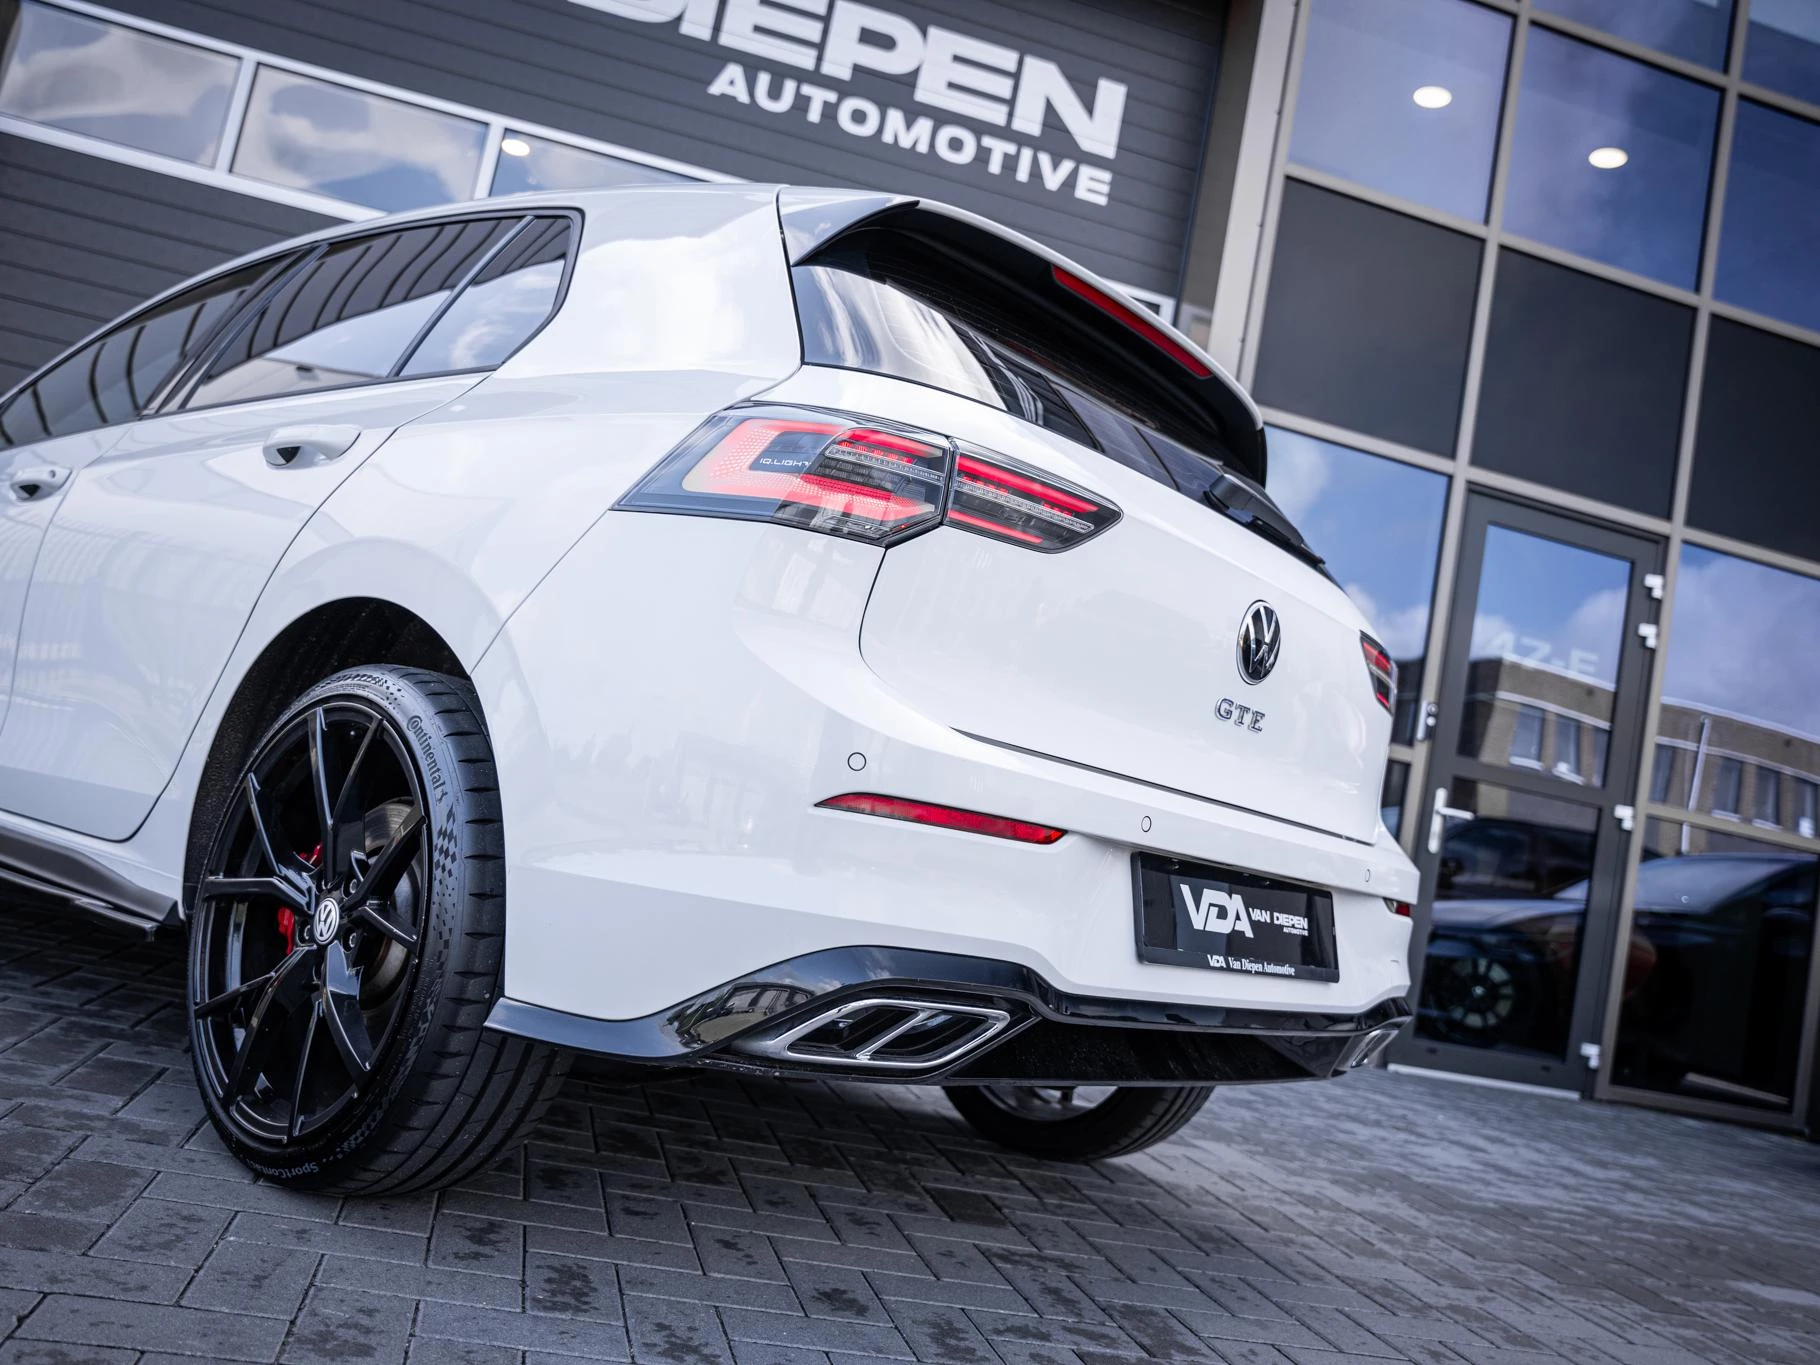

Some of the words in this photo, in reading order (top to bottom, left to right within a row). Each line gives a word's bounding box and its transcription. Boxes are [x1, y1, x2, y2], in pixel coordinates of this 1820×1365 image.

[566, 0, 1128, 160] EPEN
[706, 62, 1114, 206] AUTOMOTIVE
[1215, 697, 1266, 733] GTE
[406, 715, 446, 792] Continental
[1180, 883, 1254, 938] VDA
[1249, 907, 1270, 923] VAN
[1273, 912, 1308, 929] DIEPEN
[1207, 954, 1227, 968] VDA
[1228, 957, 1241, 970] Van
[1241, 958, 1263, 974] Diepen
[1263, 961, 1296, 976] Automotive
